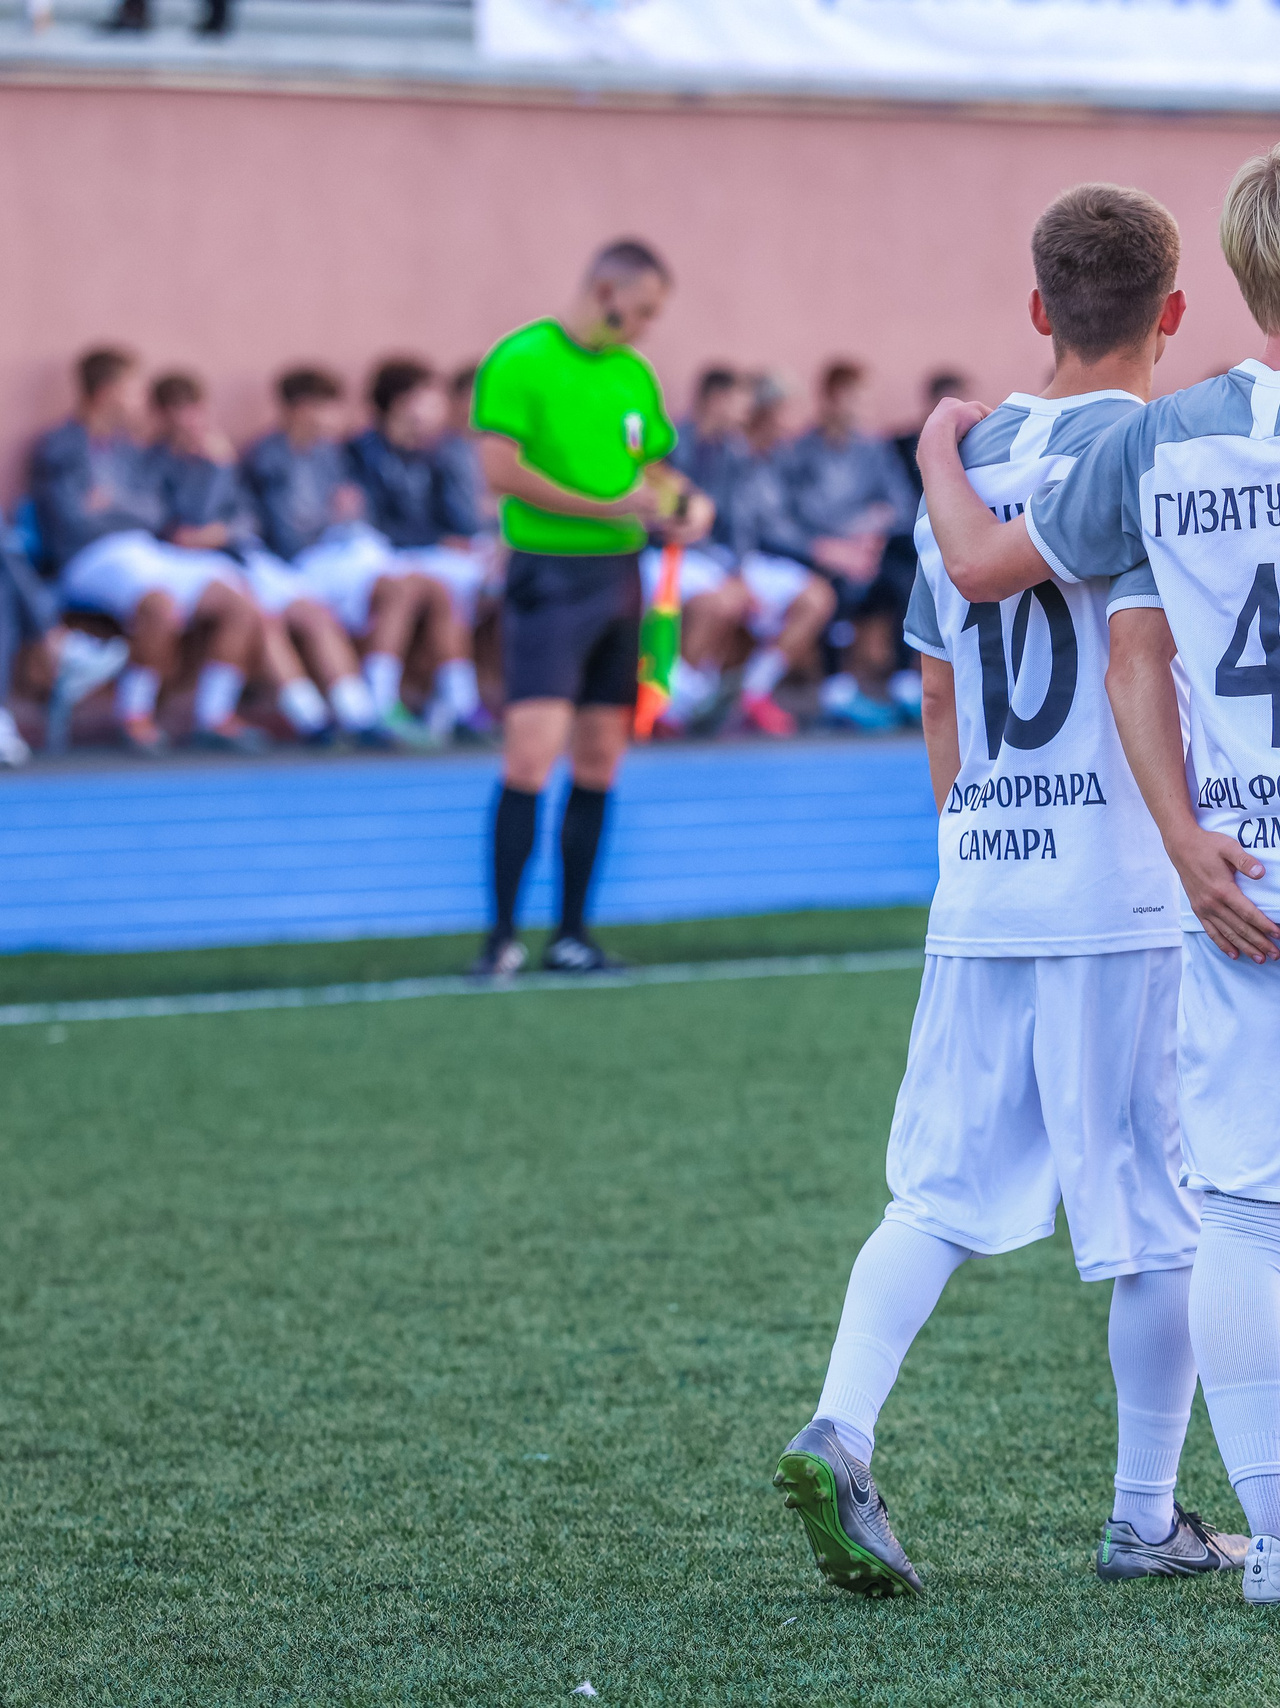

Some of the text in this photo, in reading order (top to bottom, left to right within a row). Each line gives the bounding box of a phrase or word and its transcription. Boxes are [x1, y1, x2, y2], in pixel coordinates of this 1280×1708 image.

[961, 578, 1079, 760] 10
[1198, 776, 1248, 810] ДФЦ
[959, 828, 1057, 861] САМАРА
[1255, 1538, 1264, 1552] 4
